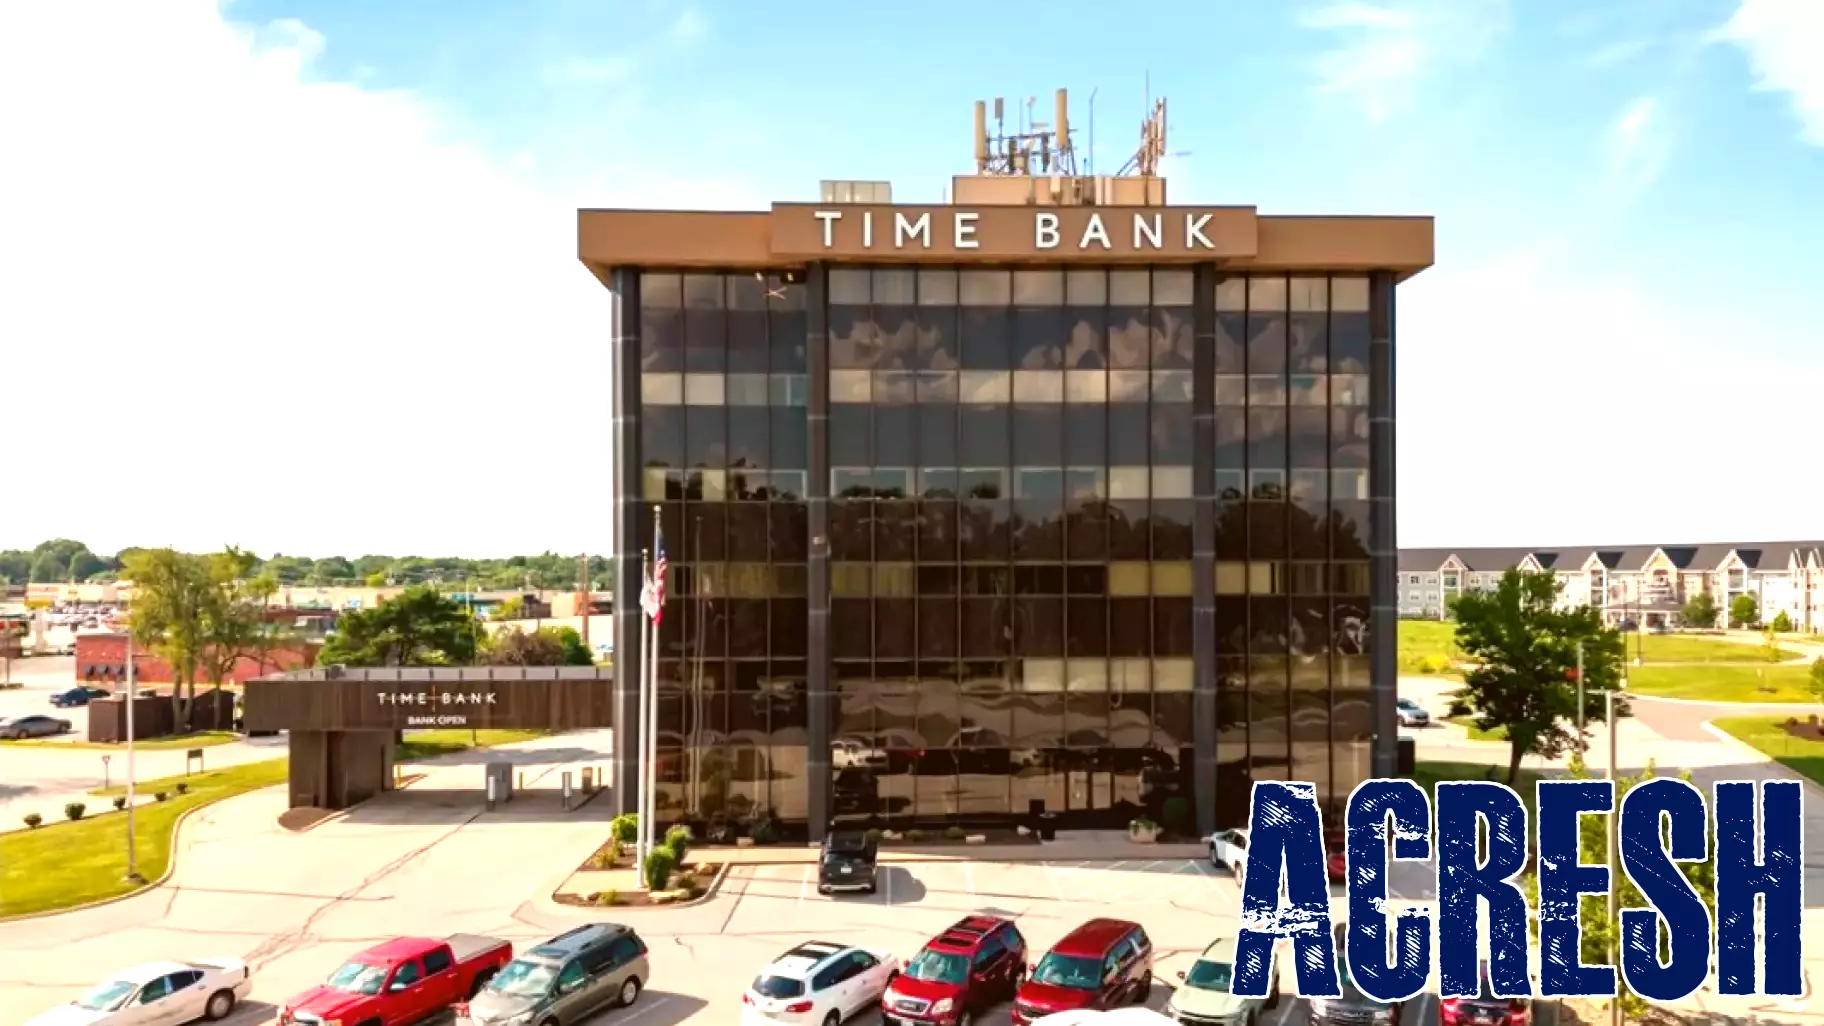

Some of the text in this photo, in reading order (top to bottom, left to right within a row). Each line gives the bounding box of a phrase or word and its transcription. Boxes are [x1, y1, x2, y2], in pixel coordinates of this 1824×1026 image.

[814, 211, 1216, 248] TIME BANK
[377, 692, 496, 704] TIME BANK
[407, 716, 467, 725] BANK OPEN
